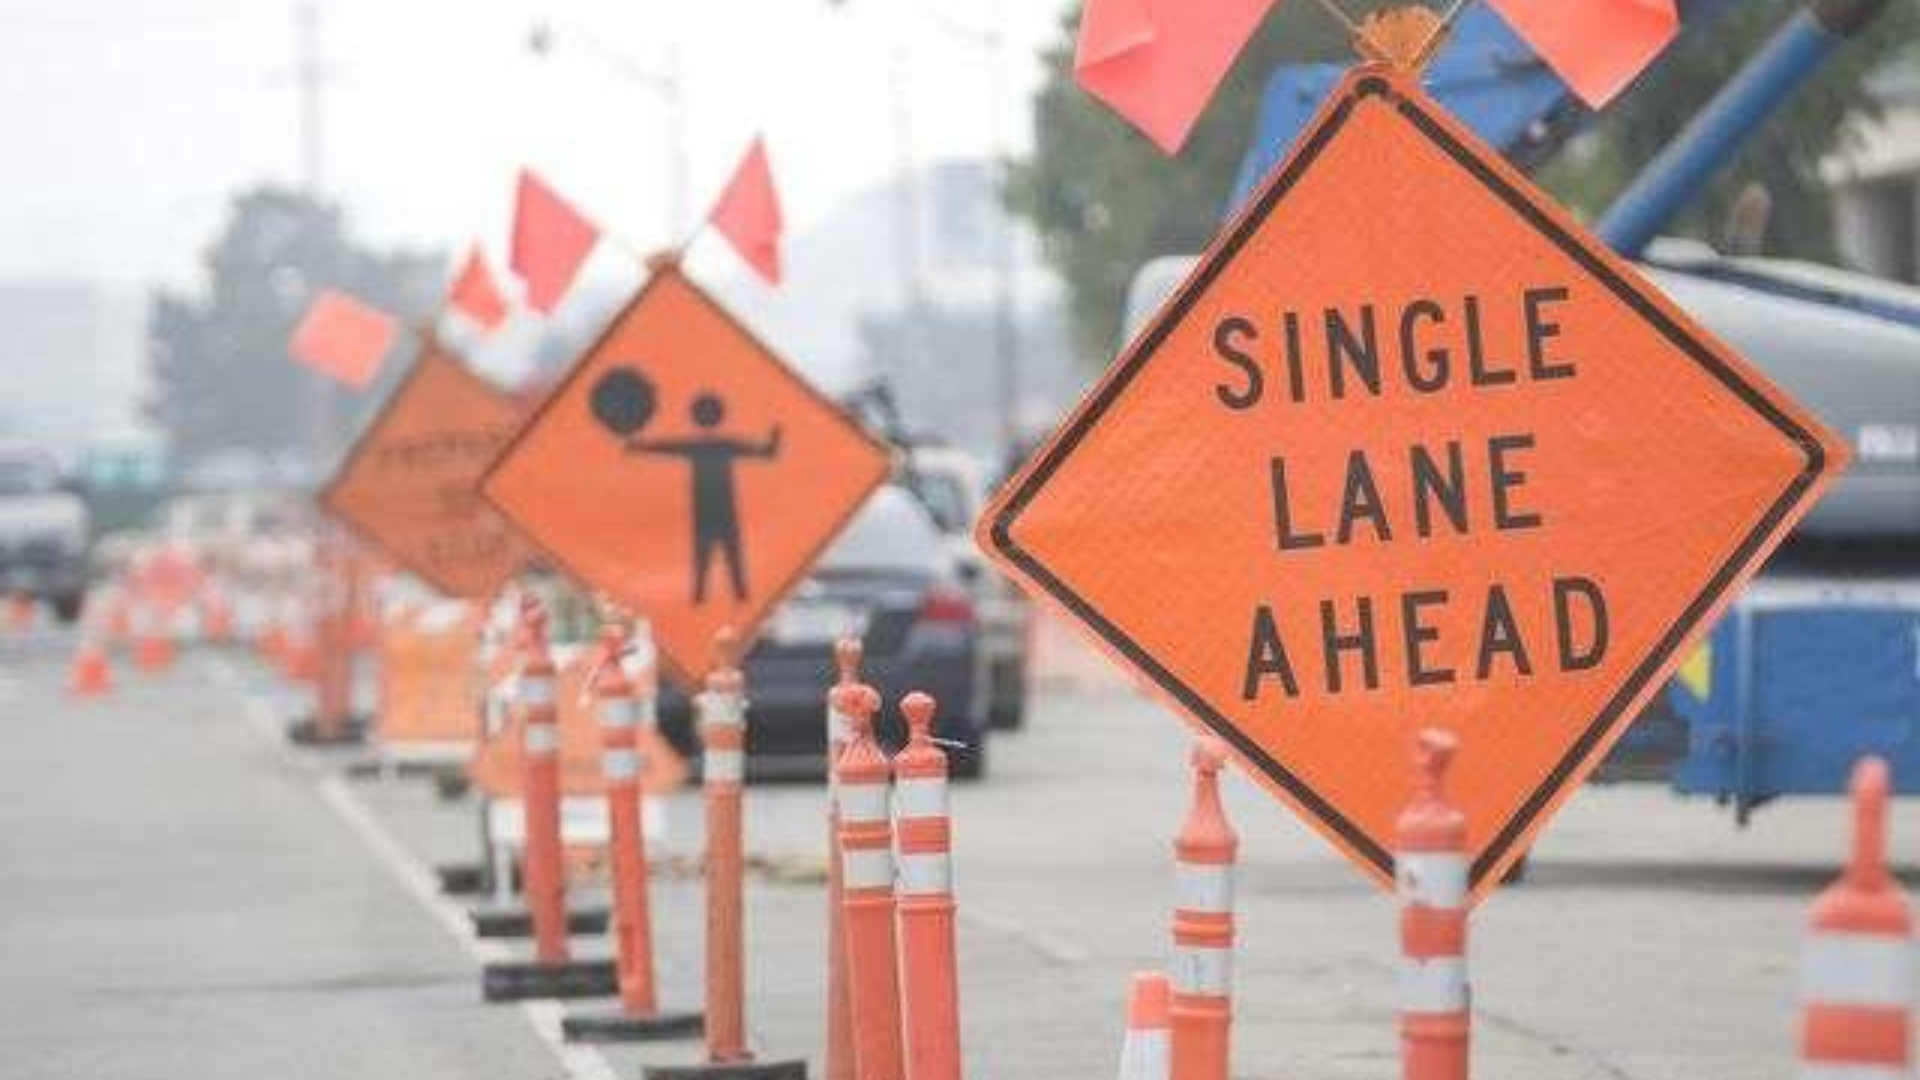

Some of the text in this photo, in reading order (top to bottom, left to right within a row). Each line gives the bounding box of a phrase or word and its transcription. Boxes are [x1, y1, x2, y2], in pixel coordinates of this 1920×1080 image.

[1213, 287, 1576, 409] SINGLE
[1271, 434, 1542, 551] LANE
[1242, 576, 1609, 701] AHEAD
